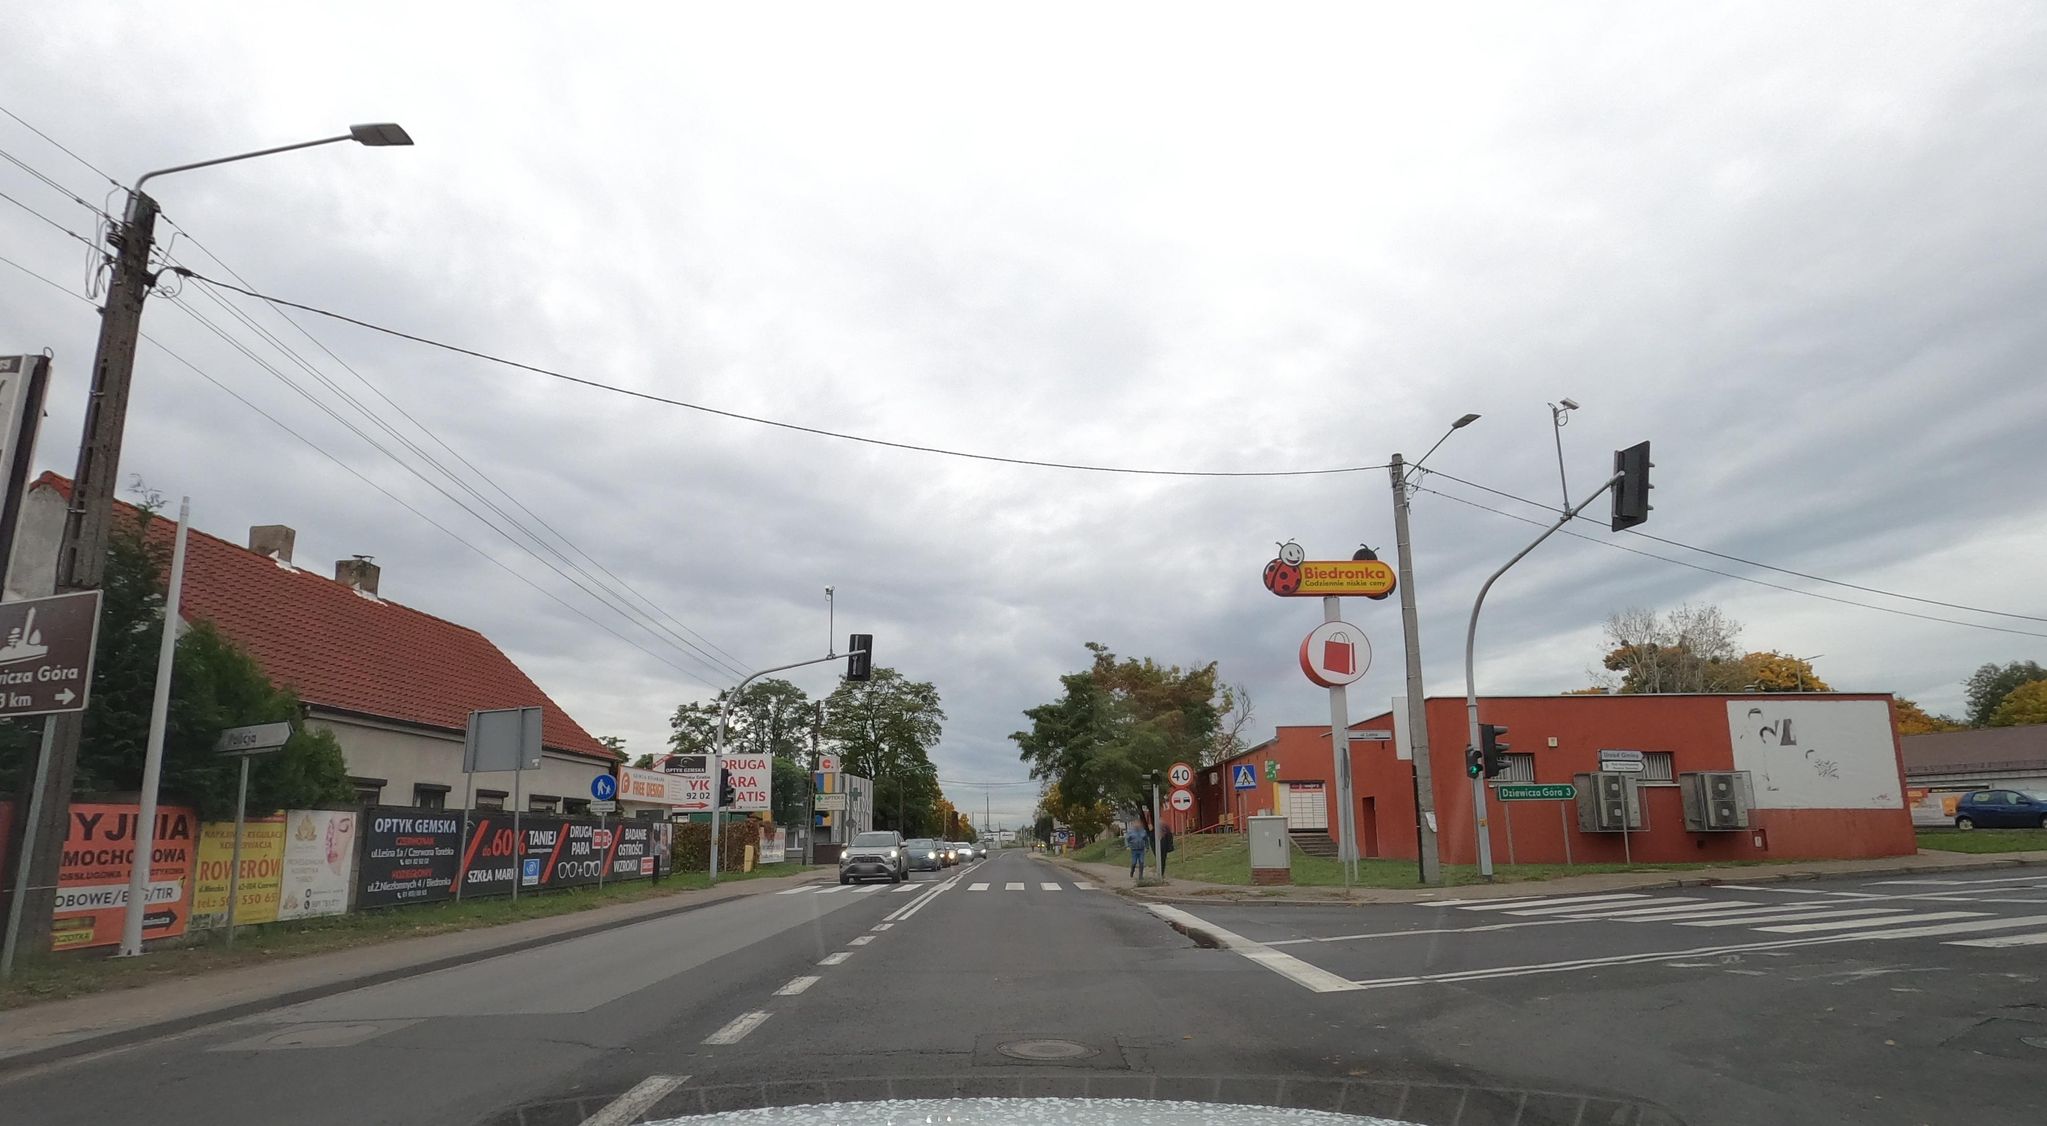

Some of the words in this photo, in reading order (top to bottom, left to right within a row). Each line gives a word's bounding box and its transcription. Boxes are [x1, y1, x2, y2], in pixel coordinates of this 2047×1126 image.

[1304, 567, 1386, 579] Biedronka
[37, 664, 79, 682] Góra
[9, 692, 32, 707] km
[721, 759, 766, 770] DRUGA
[1172, 770, 1190, 781] 40
[689, 780, 710, 790] YK
[729, 776, 757, 788] ARA
[632, 781, 644, 796] FREE
[1502, 788, 1541, 797] Dziewicza
[1542, 786, 1562, 797] Góra
[1566, 788, 1572, 796] 3
[686, 792, 696, 800] 92
[700, 792, 710, 800] 02
[737, 792, 766, 802] ATIS
[65, 812, 189, 841] YJIA
[374, 818, 413, 833] OPTYK
[415, 820, 456, 834] GEMSKA
[570, 826, 592, 838] DRUGA
[529, 830, 556, 846] TANIEJ
[624, 828, 647, 840] BADANIE
[571, 842, 590, 856] PARA
[618, 841, 644, 856] OSTROŚCI
[61, 848, 186, 867] MOCHOOWA
[200, 854, 280, 880] ROWERÓW
[614, 860, 638, 872] WZROKU
[468, 869, 492, 883] SZKŁA
[242, 894, 261, 905] 550
